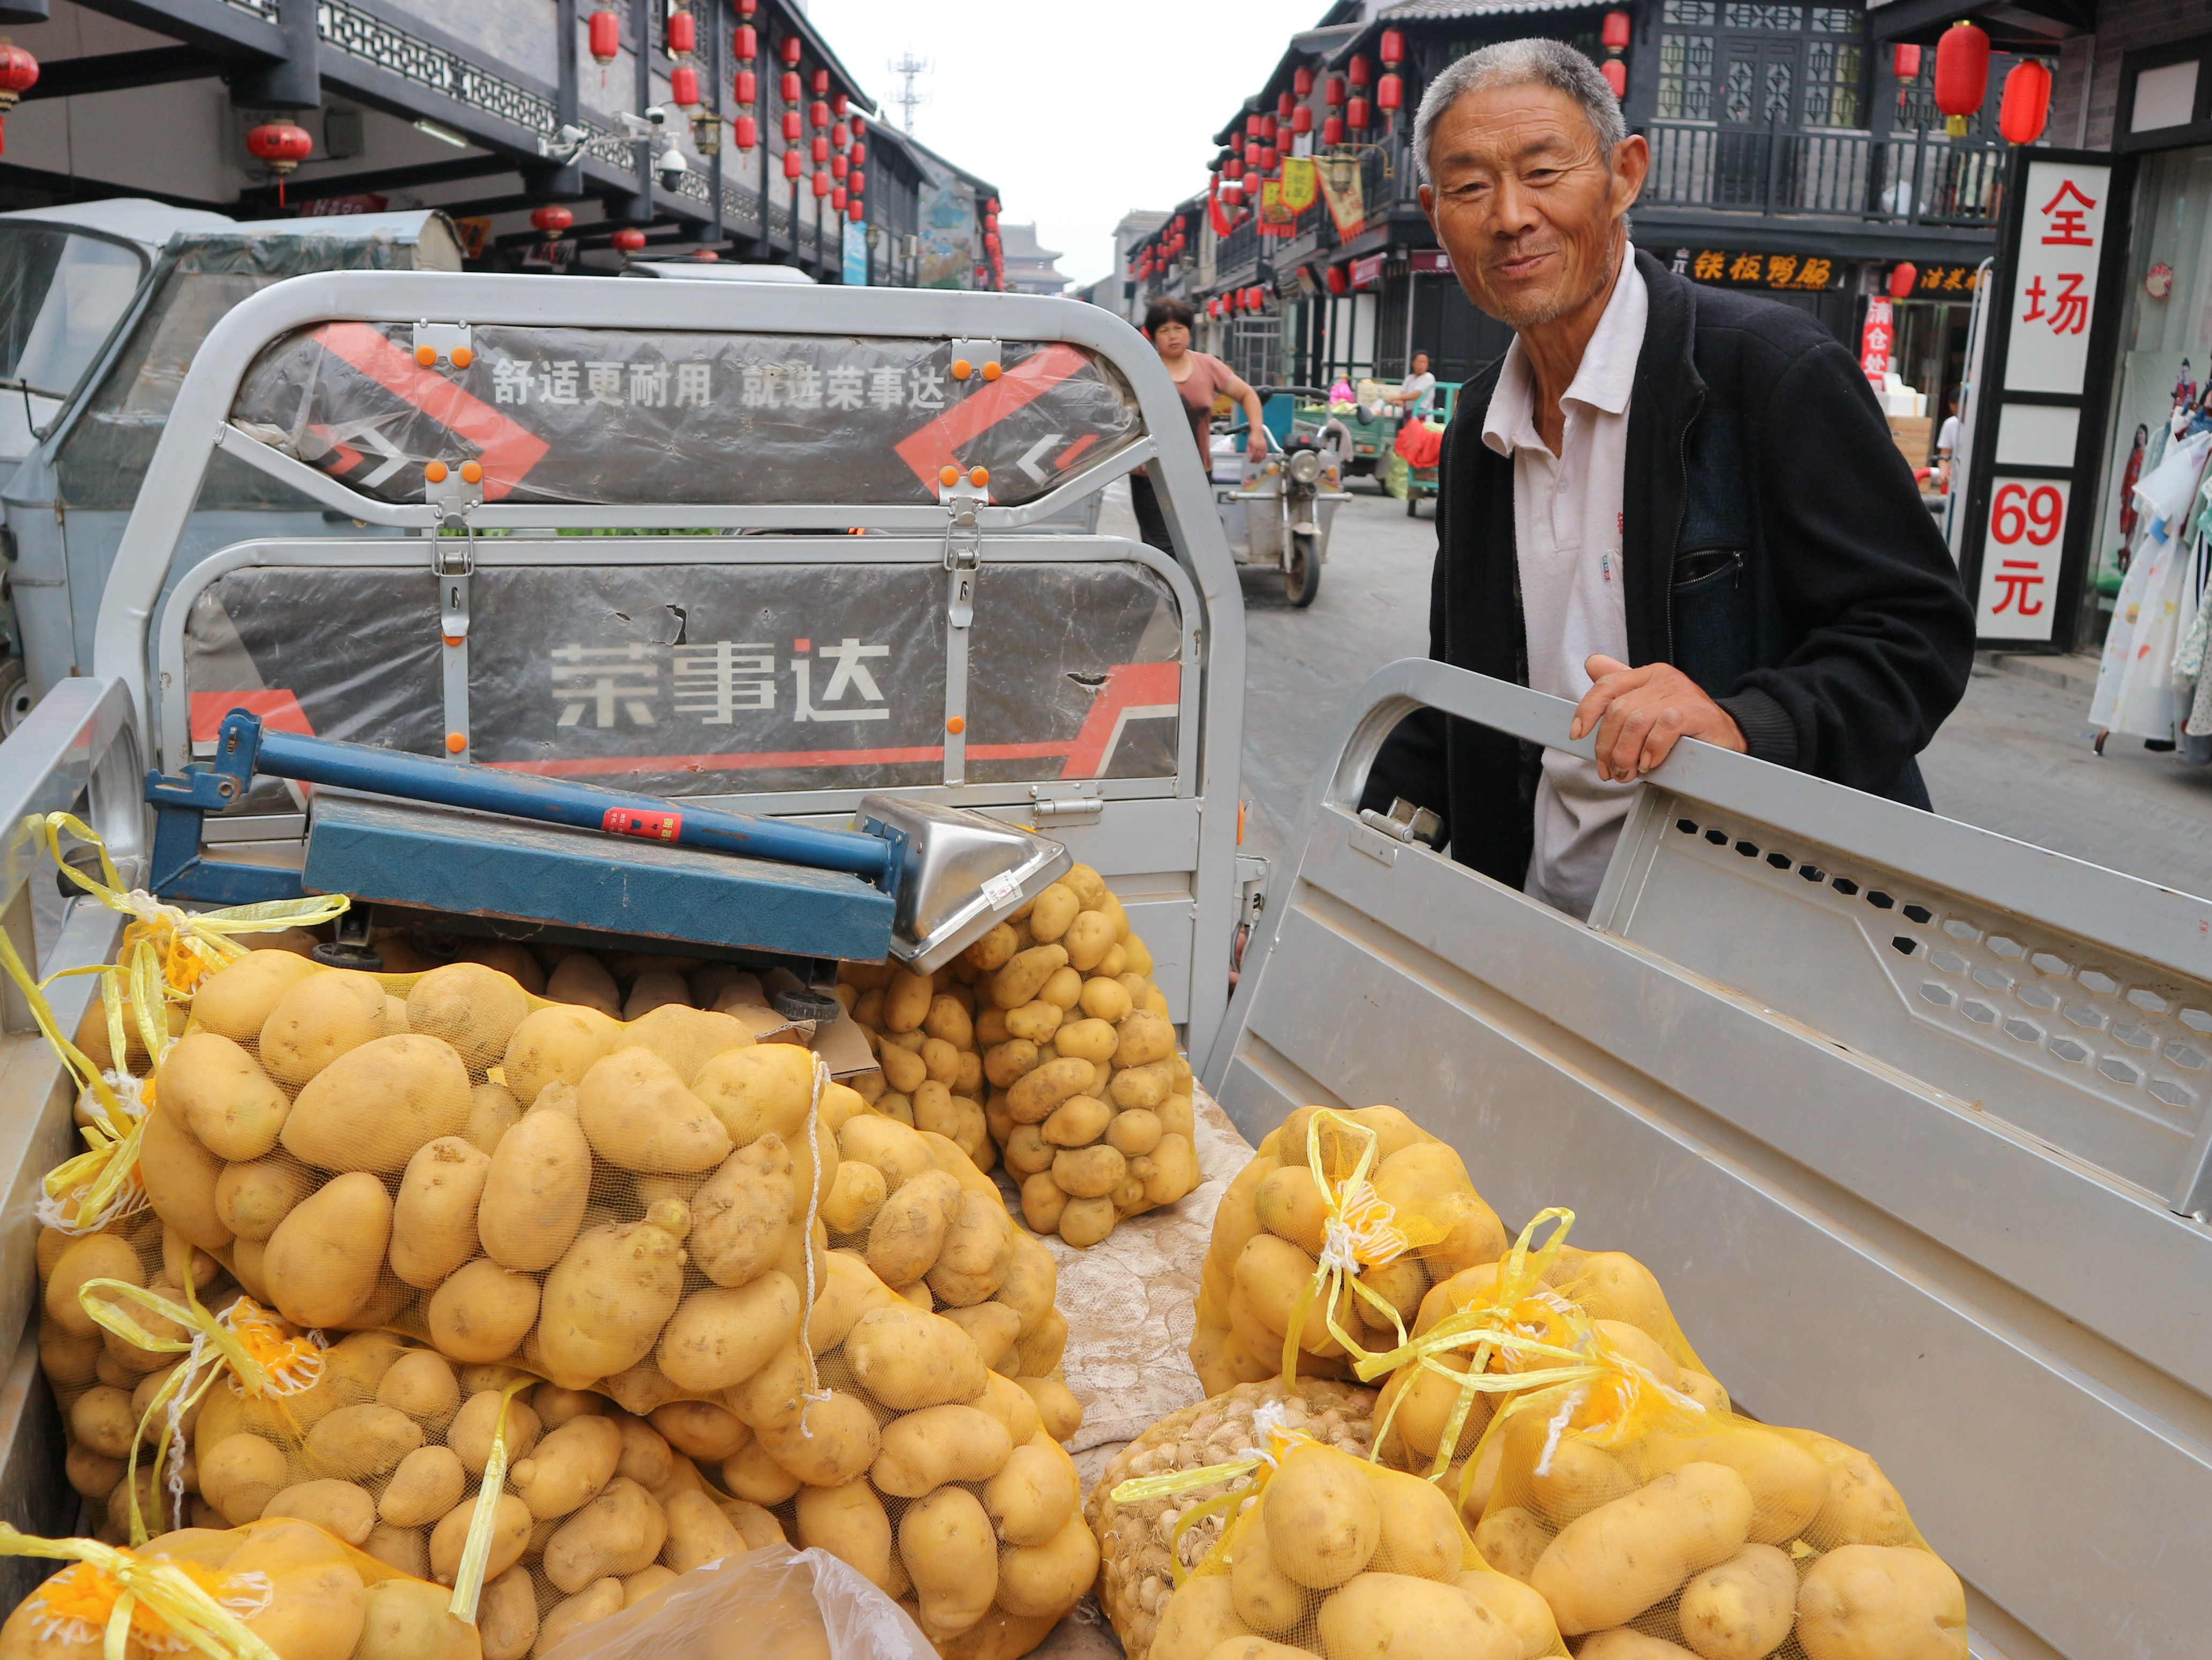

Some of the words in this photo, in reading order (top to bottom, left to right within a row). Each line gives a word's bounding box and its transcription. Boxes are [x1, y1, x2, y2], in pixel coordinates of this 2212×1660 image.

[1694, 250, 1831, 283] 铁板鸭肠
[2022, 179, 2096, 335] 全场
[492, 358, 711, 407] 舒适更耐用
[741, 363, 945, 411] 就选荣事达
[551, 638, 890, 728] 荣事达
[660, 817, 674, 841] 衡器
